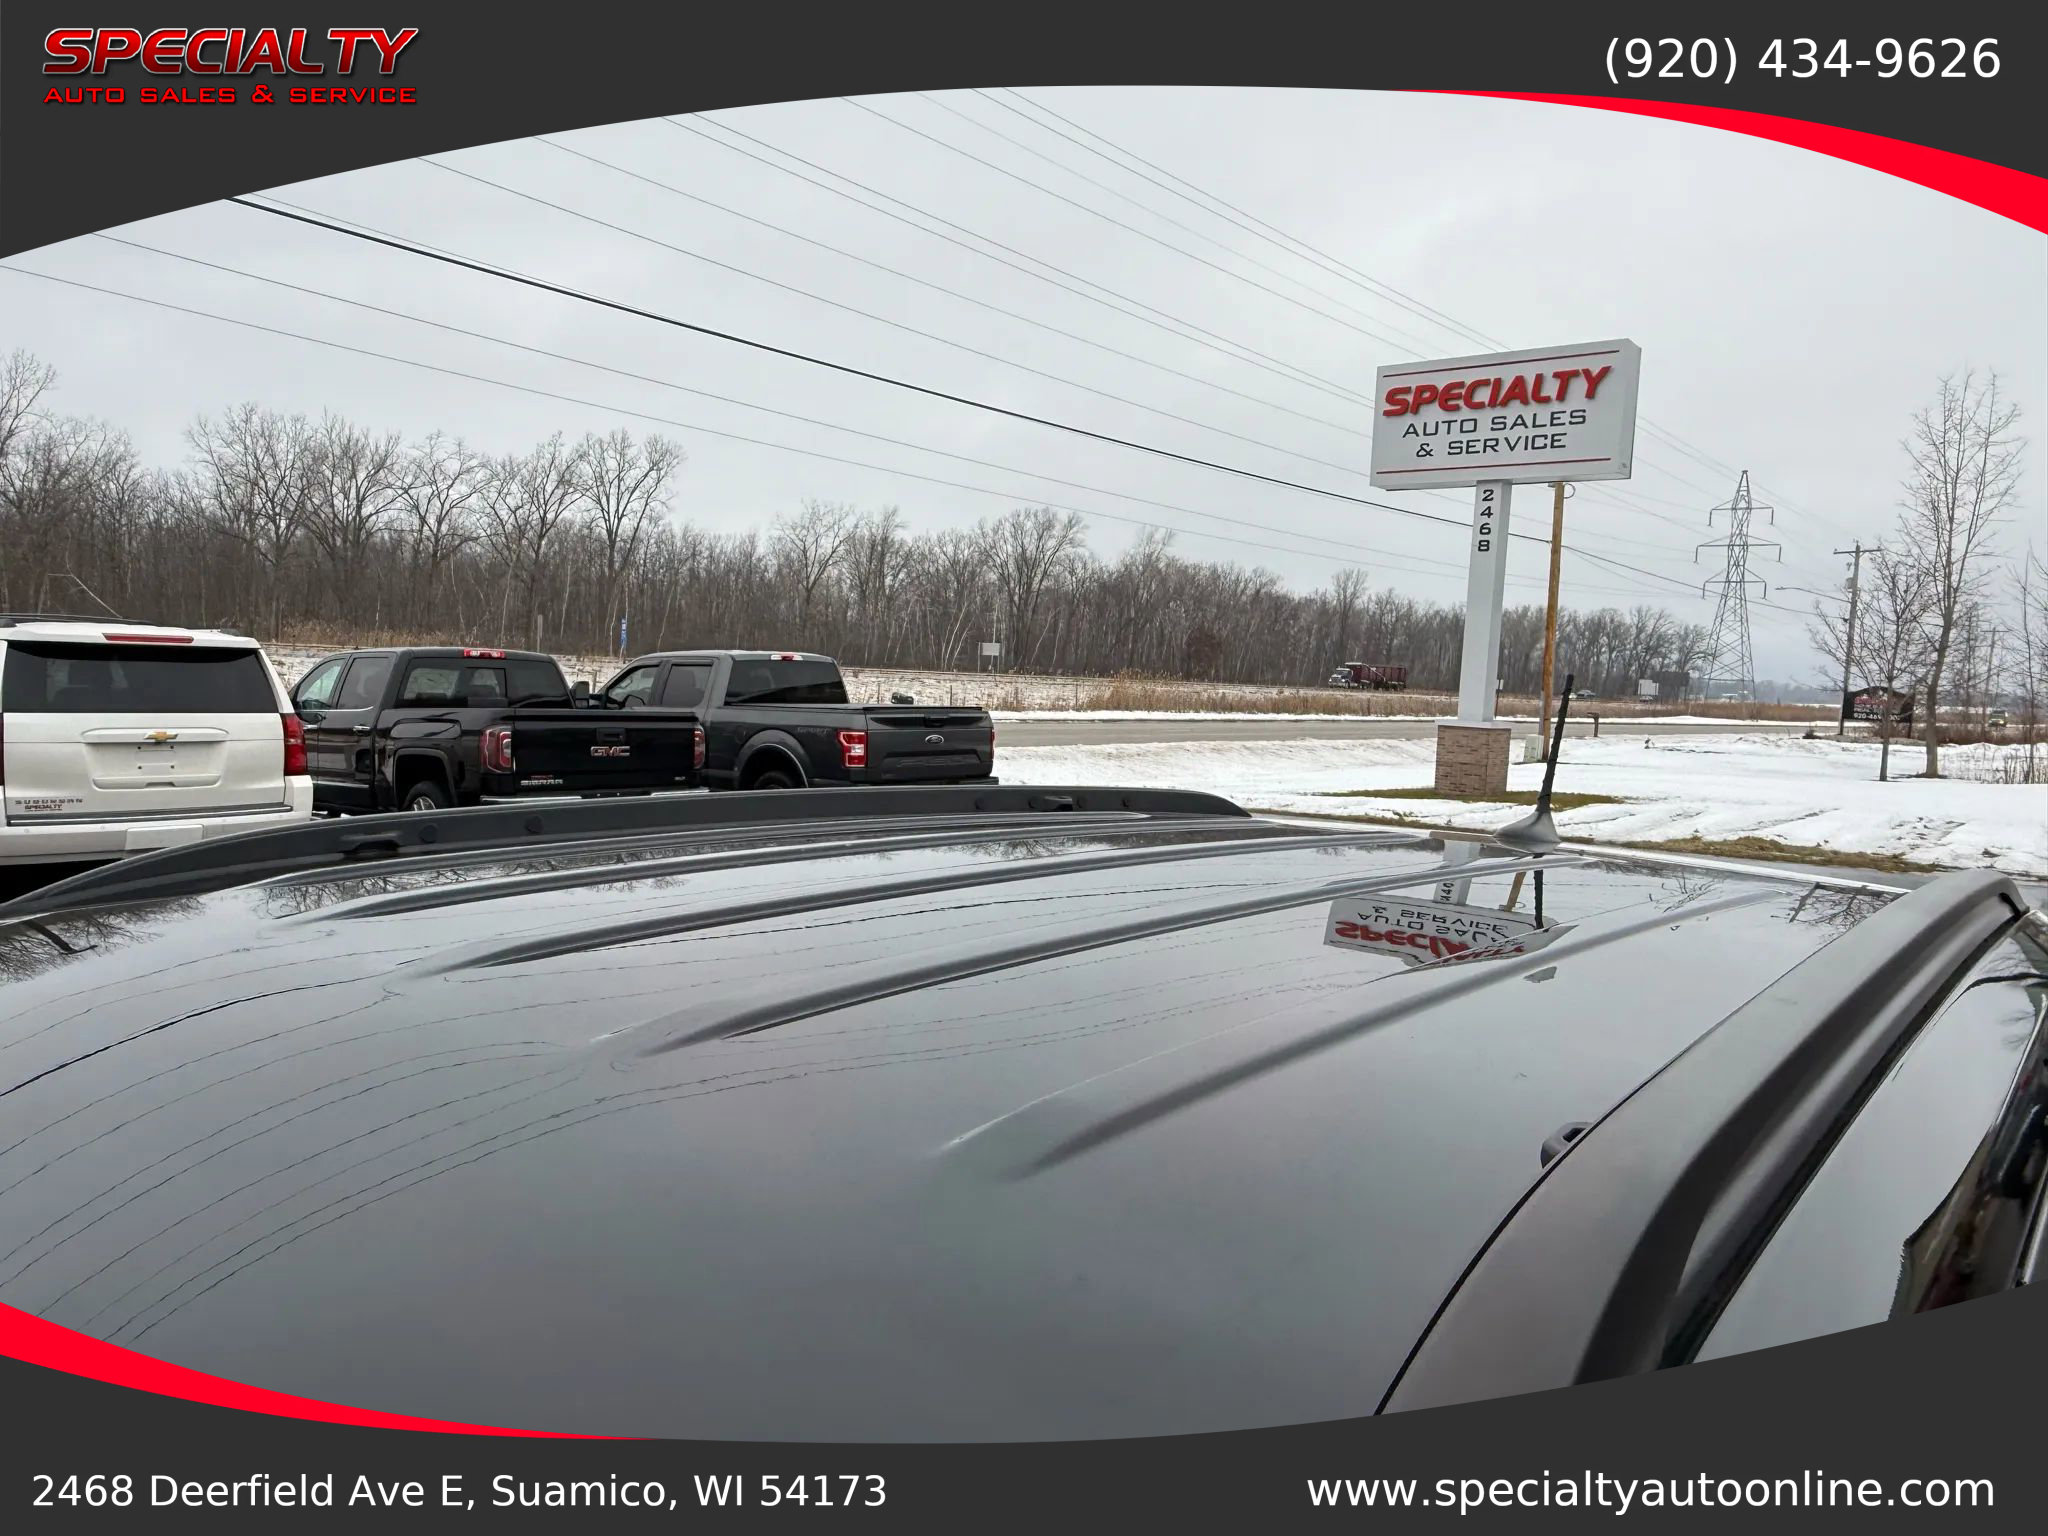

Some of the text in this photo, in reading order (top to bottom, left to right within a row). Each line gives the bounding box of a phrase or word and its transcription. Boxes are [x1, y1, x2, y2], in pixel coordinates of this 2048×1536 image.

[1382, 365, 1613, 417] SPECIALTY
[1402, 409, 1587, 438] AUTO SALES
[1415, 433, 1568, 458] & SERVICE
[1477, 488, 1495, 552] 2468
[590, 745, 631, 757] GMC
